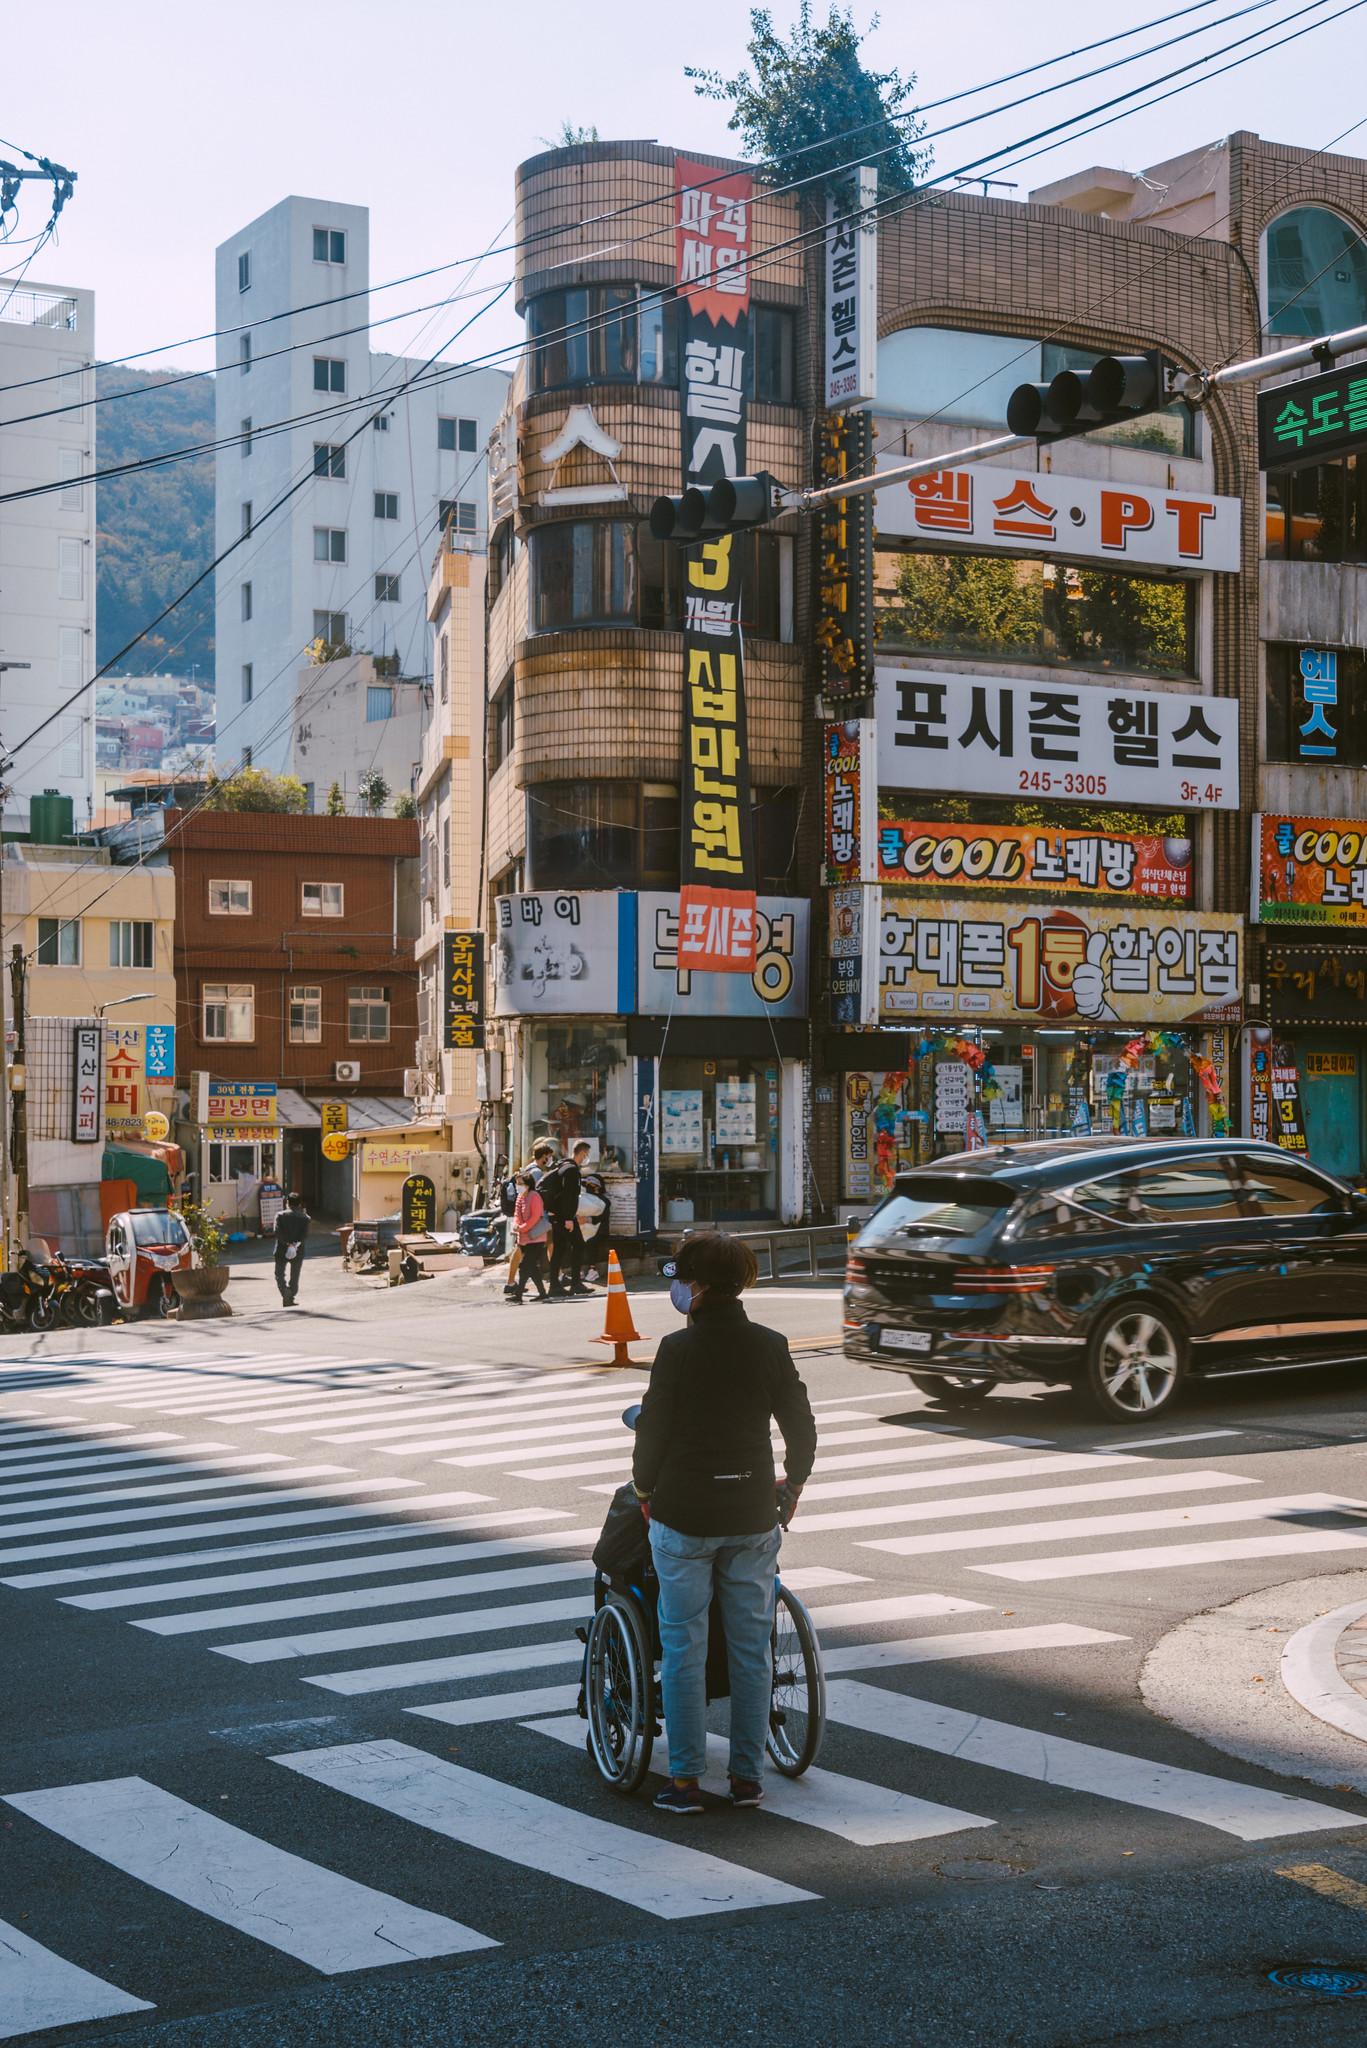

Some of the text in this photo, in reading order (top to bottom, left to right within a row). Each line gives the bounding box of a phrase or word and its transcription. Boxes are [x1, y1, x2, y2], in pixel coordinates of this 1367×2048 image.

[831, 298, 857, 375] 헬스
[894, 679, 1222, 771] 포시즌 헬스
[1299, 647, 1338, 757] 헬스
[1018, 770, 1107, 796] 245-3305
[831, 775, 855, 863] 노래방
[878, 828, 1137, 891] 쿨 COOL 노래방
[682, 902, 754, 957] 포시즌
[879, 911, 1005, 988] 휴대폰
[1108, 922, 1241, 997] 할인점
[451, 935, 476, 1001] 우리사이
[448, 1001, 479, 1014] 노래
[451, 1014, 476, 1046] 주점
[148, 1027, 168, 1075] 은하수
[105, 1048, 140, 1116] 슈퍼
[208, 1098, 270, 1117] 밀냉면
[1272, 1082, 1298, 1100] 헬스
[850, 1110, 869, 1160] 할인점
[1281, 1100, 1294, 1122] 3
[325, 1140, 348, 1155] 수연
